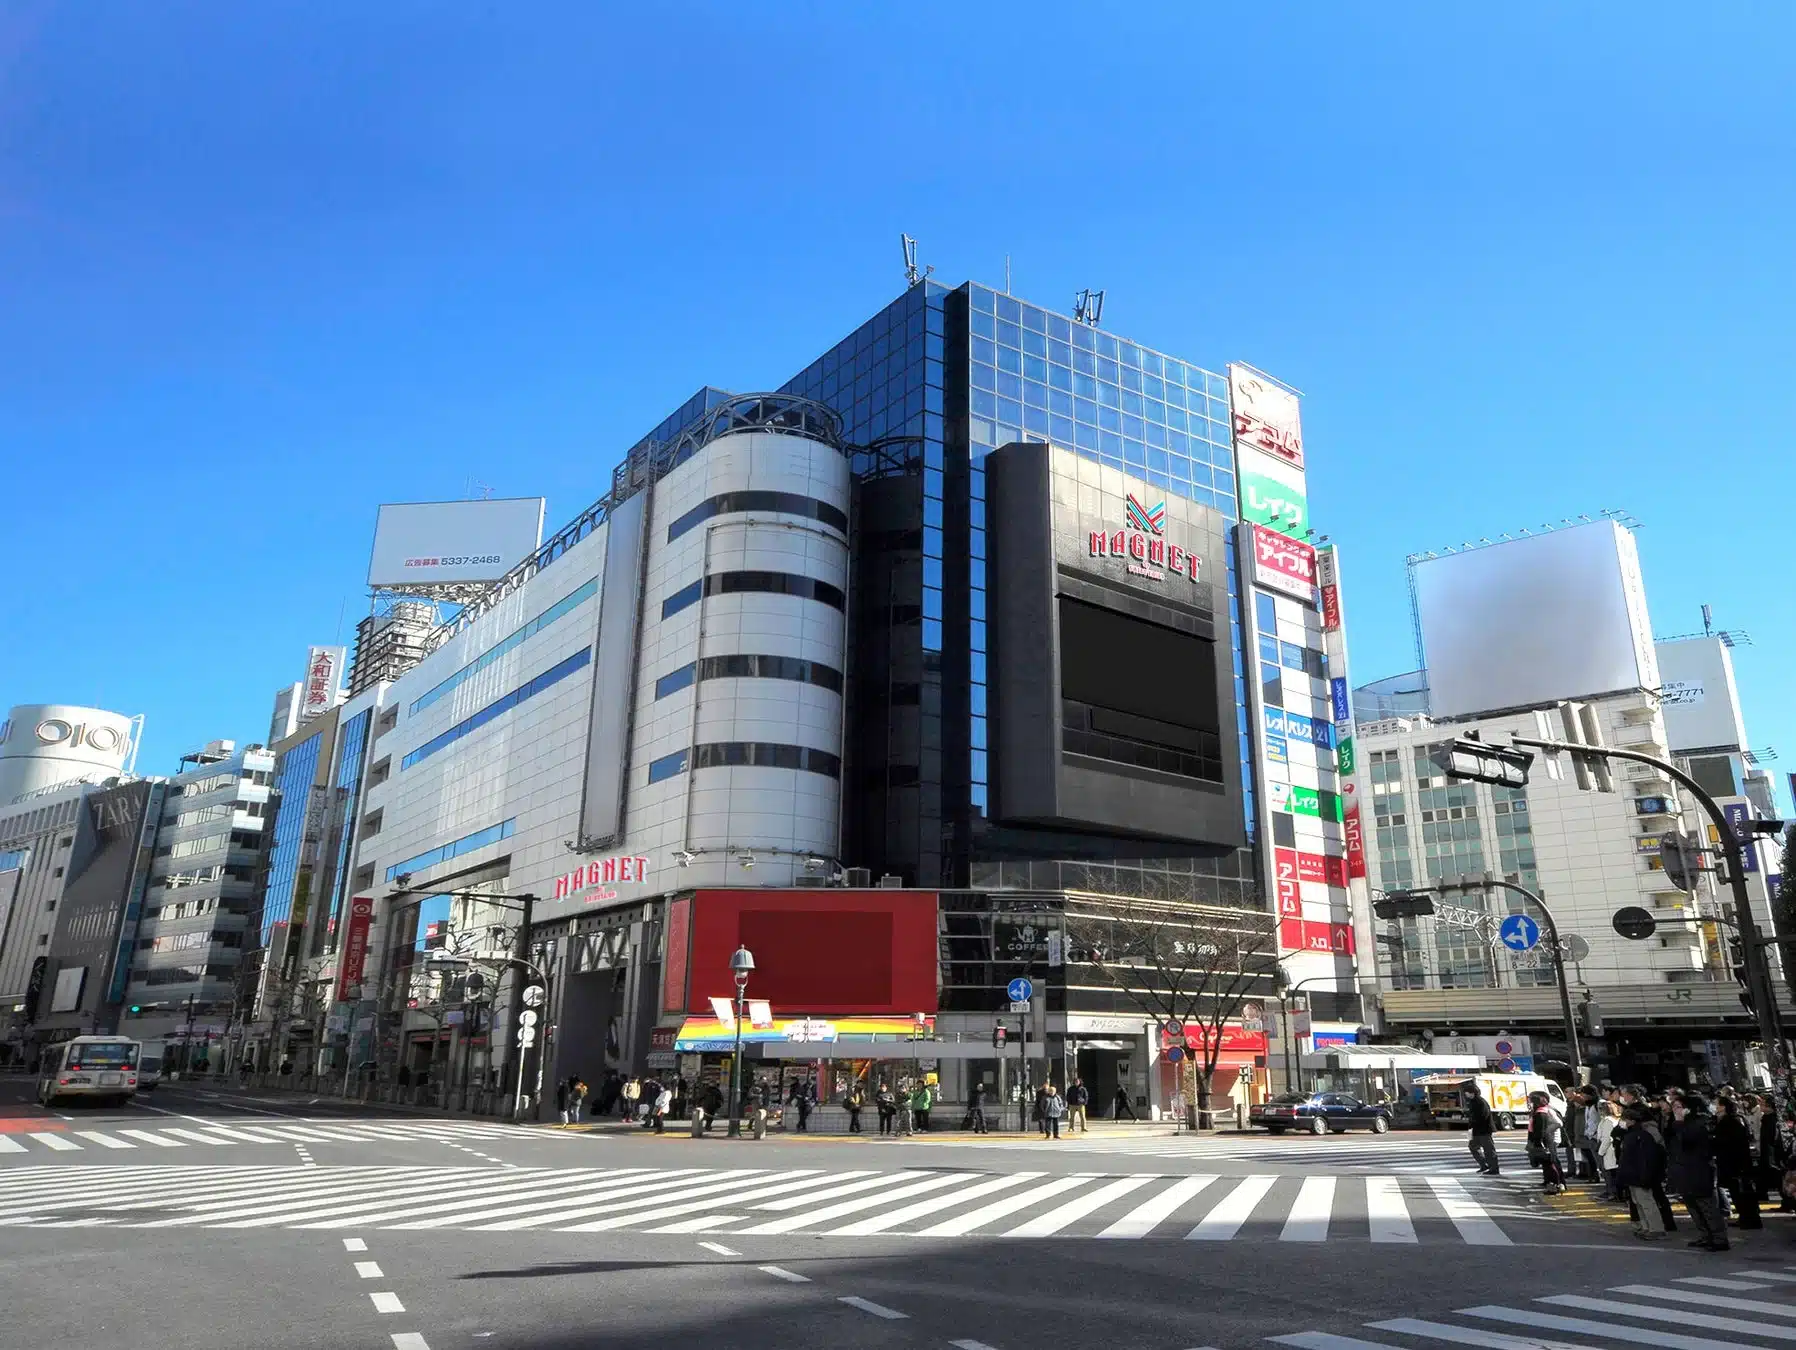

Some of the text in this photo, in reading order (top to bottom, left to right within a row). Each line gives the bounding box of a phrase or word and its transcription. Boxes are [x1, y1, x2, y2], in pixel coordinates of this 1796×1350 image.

[1248, 486, 1304, 527] レイク
[441, 556, 501, 566] 5337-2468
[1089, 529, 1203, 583] MAGNET
[1258, 542, 1312, 577] アイフル
[1325, 594, 1338, 627] アイフル
[308, 651, 332, 705] 大和証券
[1341, 746, 1351, 769] レイク
[1346, 818, 1361, 852] アコム
[556, 856, 648, 900] MAGNET
[1279, 862, 1296, 912] アコム
[1310, 937, 1328, 949] 入口
[1667, 988, 1693, 1001] JR
